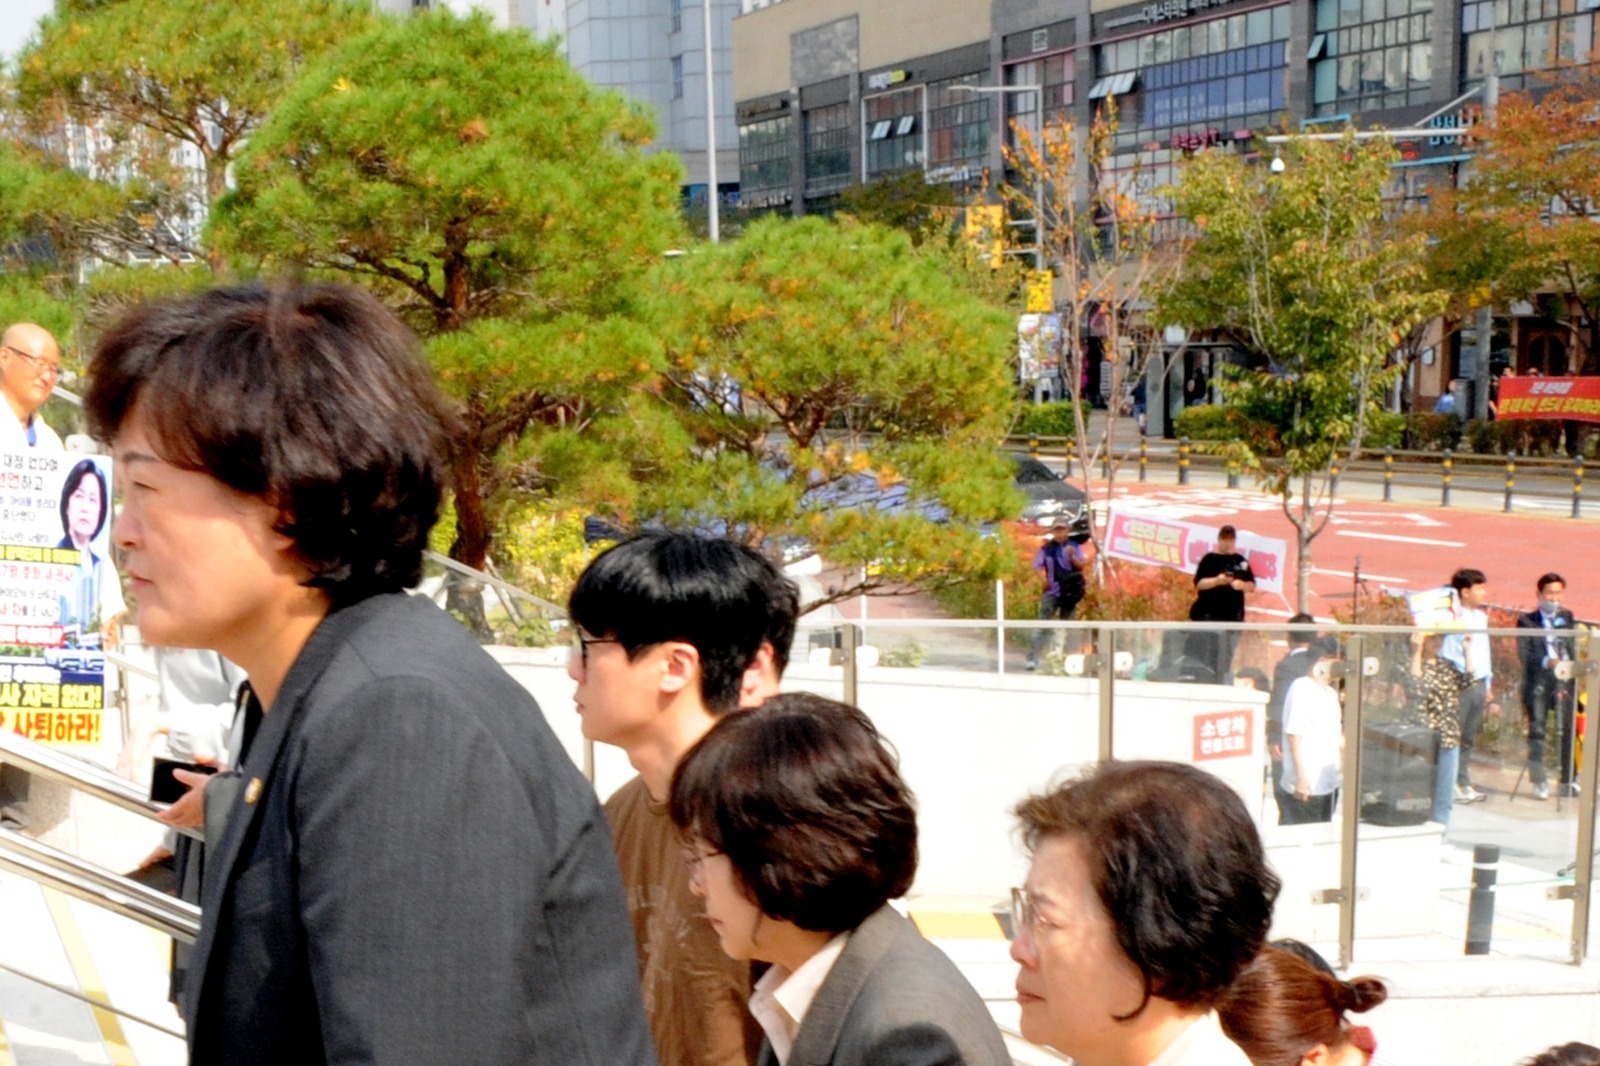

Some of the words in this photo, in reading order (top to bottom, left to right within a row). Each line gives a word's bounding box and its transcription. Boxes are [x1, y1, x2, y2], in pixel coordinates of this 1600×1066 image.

[2, 454, 24, 469] 재정
[22, 683, 60, 708] 자격
[61, 684, 102, 708] 없다!
[12, 712, 100, 742] 사퇴하라!
